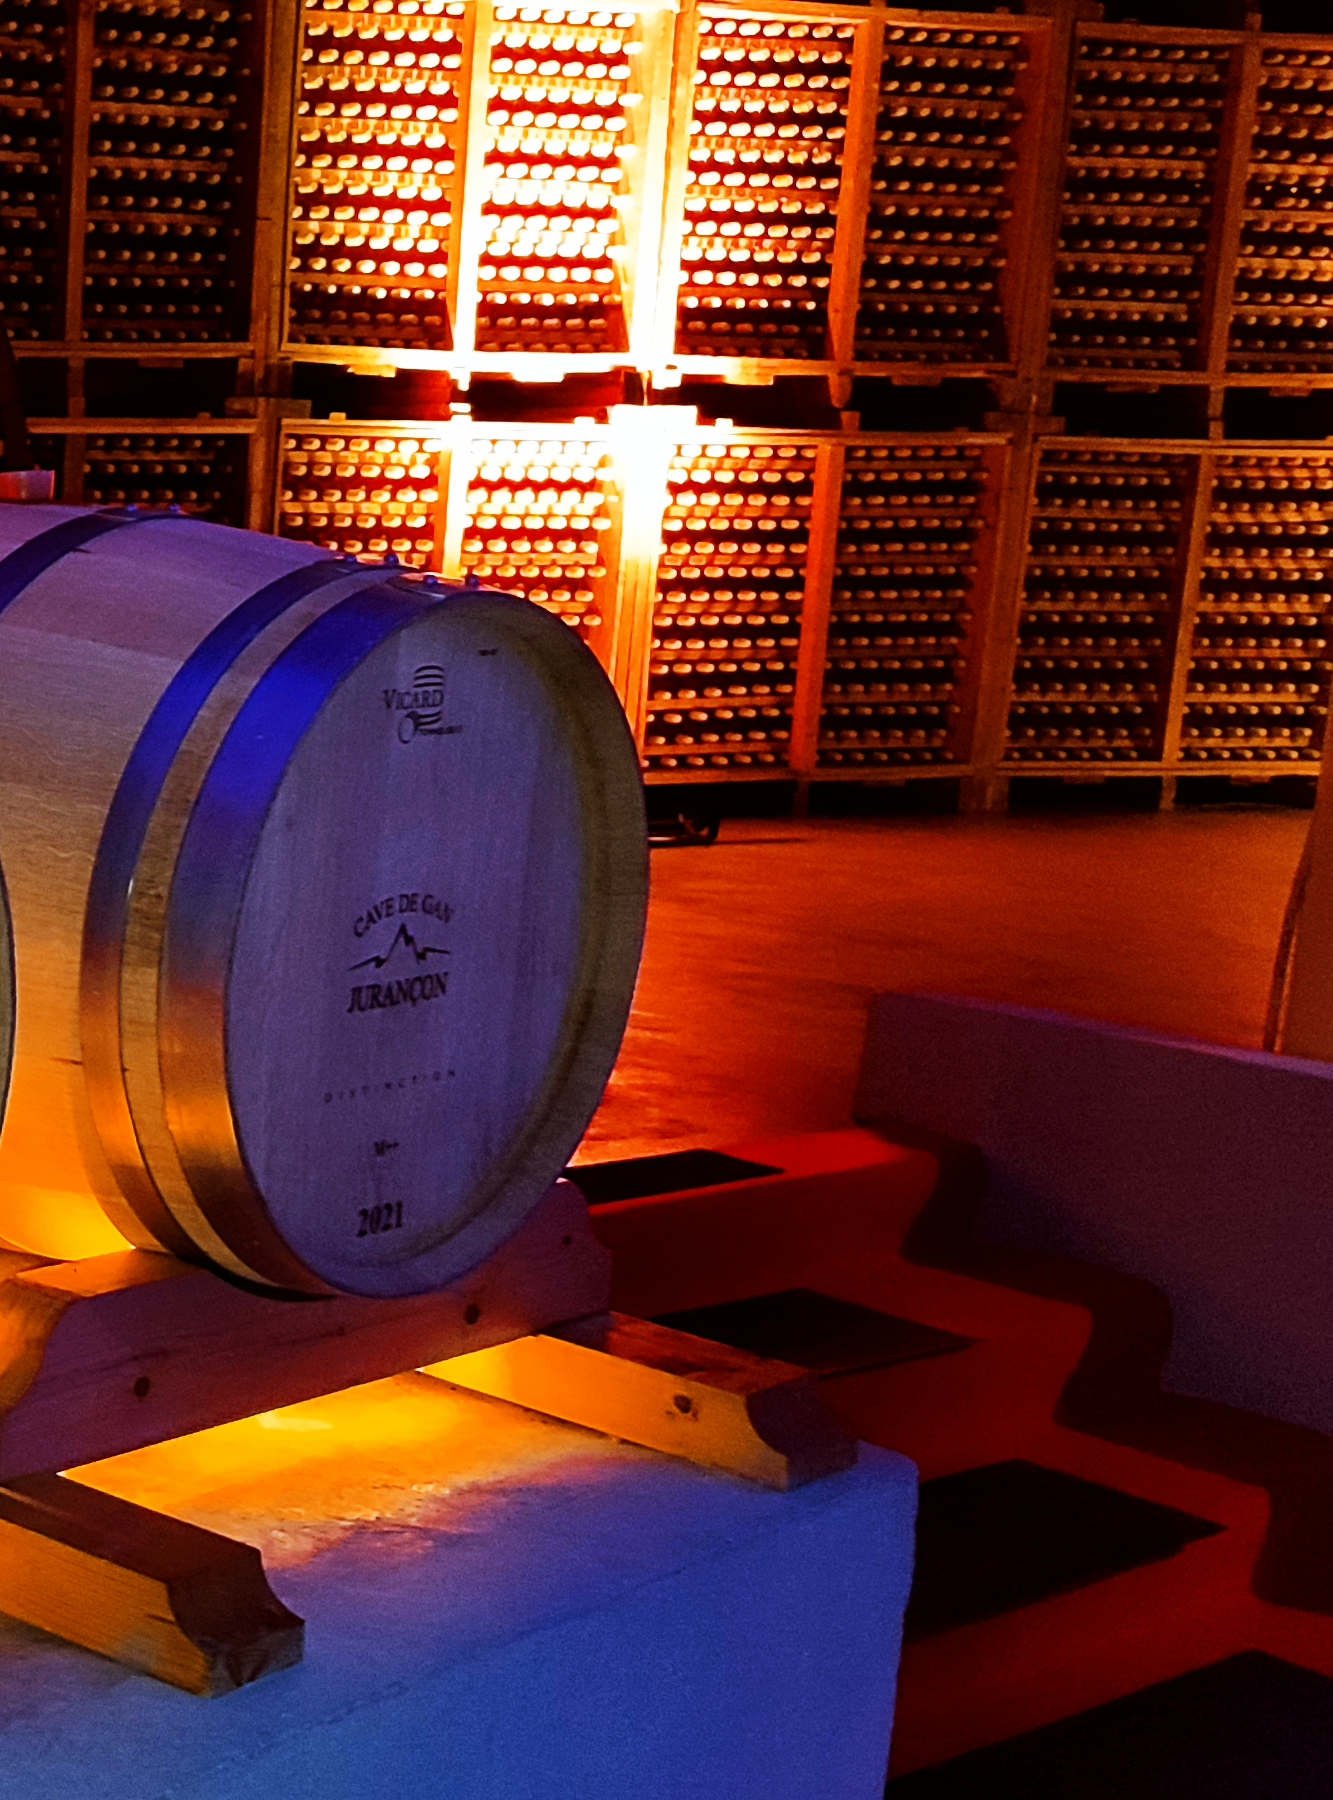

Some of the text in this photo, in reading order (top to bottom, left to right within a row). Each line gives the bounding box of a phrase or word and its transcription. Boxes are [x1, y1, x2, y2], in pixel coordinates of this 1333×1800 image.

[353, 893, 454, 938] CAVE DE GAN
[346, 971, 449, 1014] JURANÇON
[357, 1201, 403, 1238] 2021
